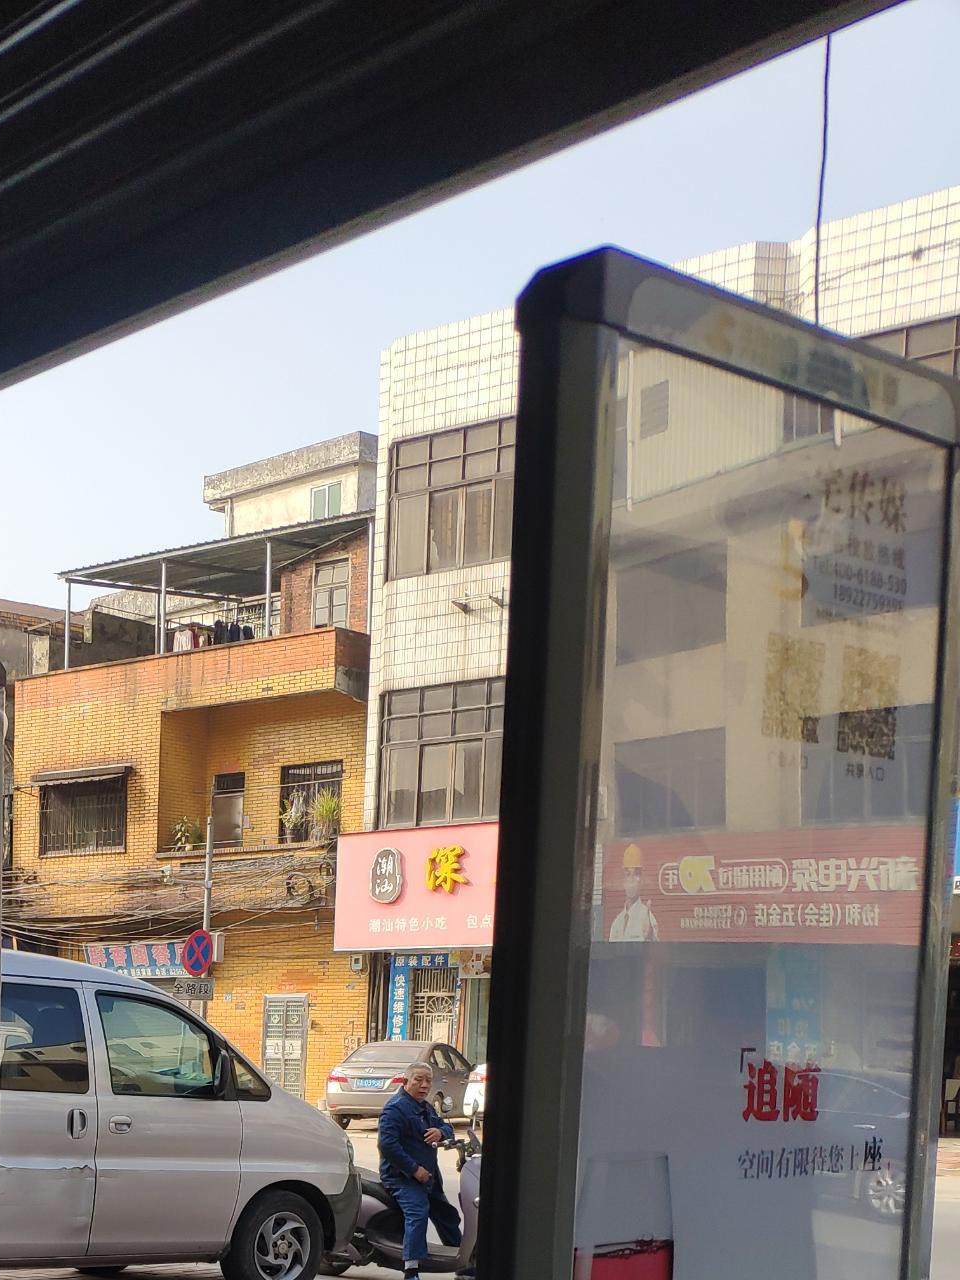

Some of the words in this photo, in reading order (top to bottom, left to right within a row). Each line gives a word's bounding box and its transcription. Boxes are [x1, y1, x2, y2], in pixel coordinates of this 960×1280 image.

[426, 844, 468, 893] 深
[368, 916, 448, 933] 潮汕特色小吃
[466, 914, 492, 929] 包点
[394, 955, 445, 967] 原装配件
[174, 983, 210, 995] 全路段
[742, 1058, 822, 1122] 追随
